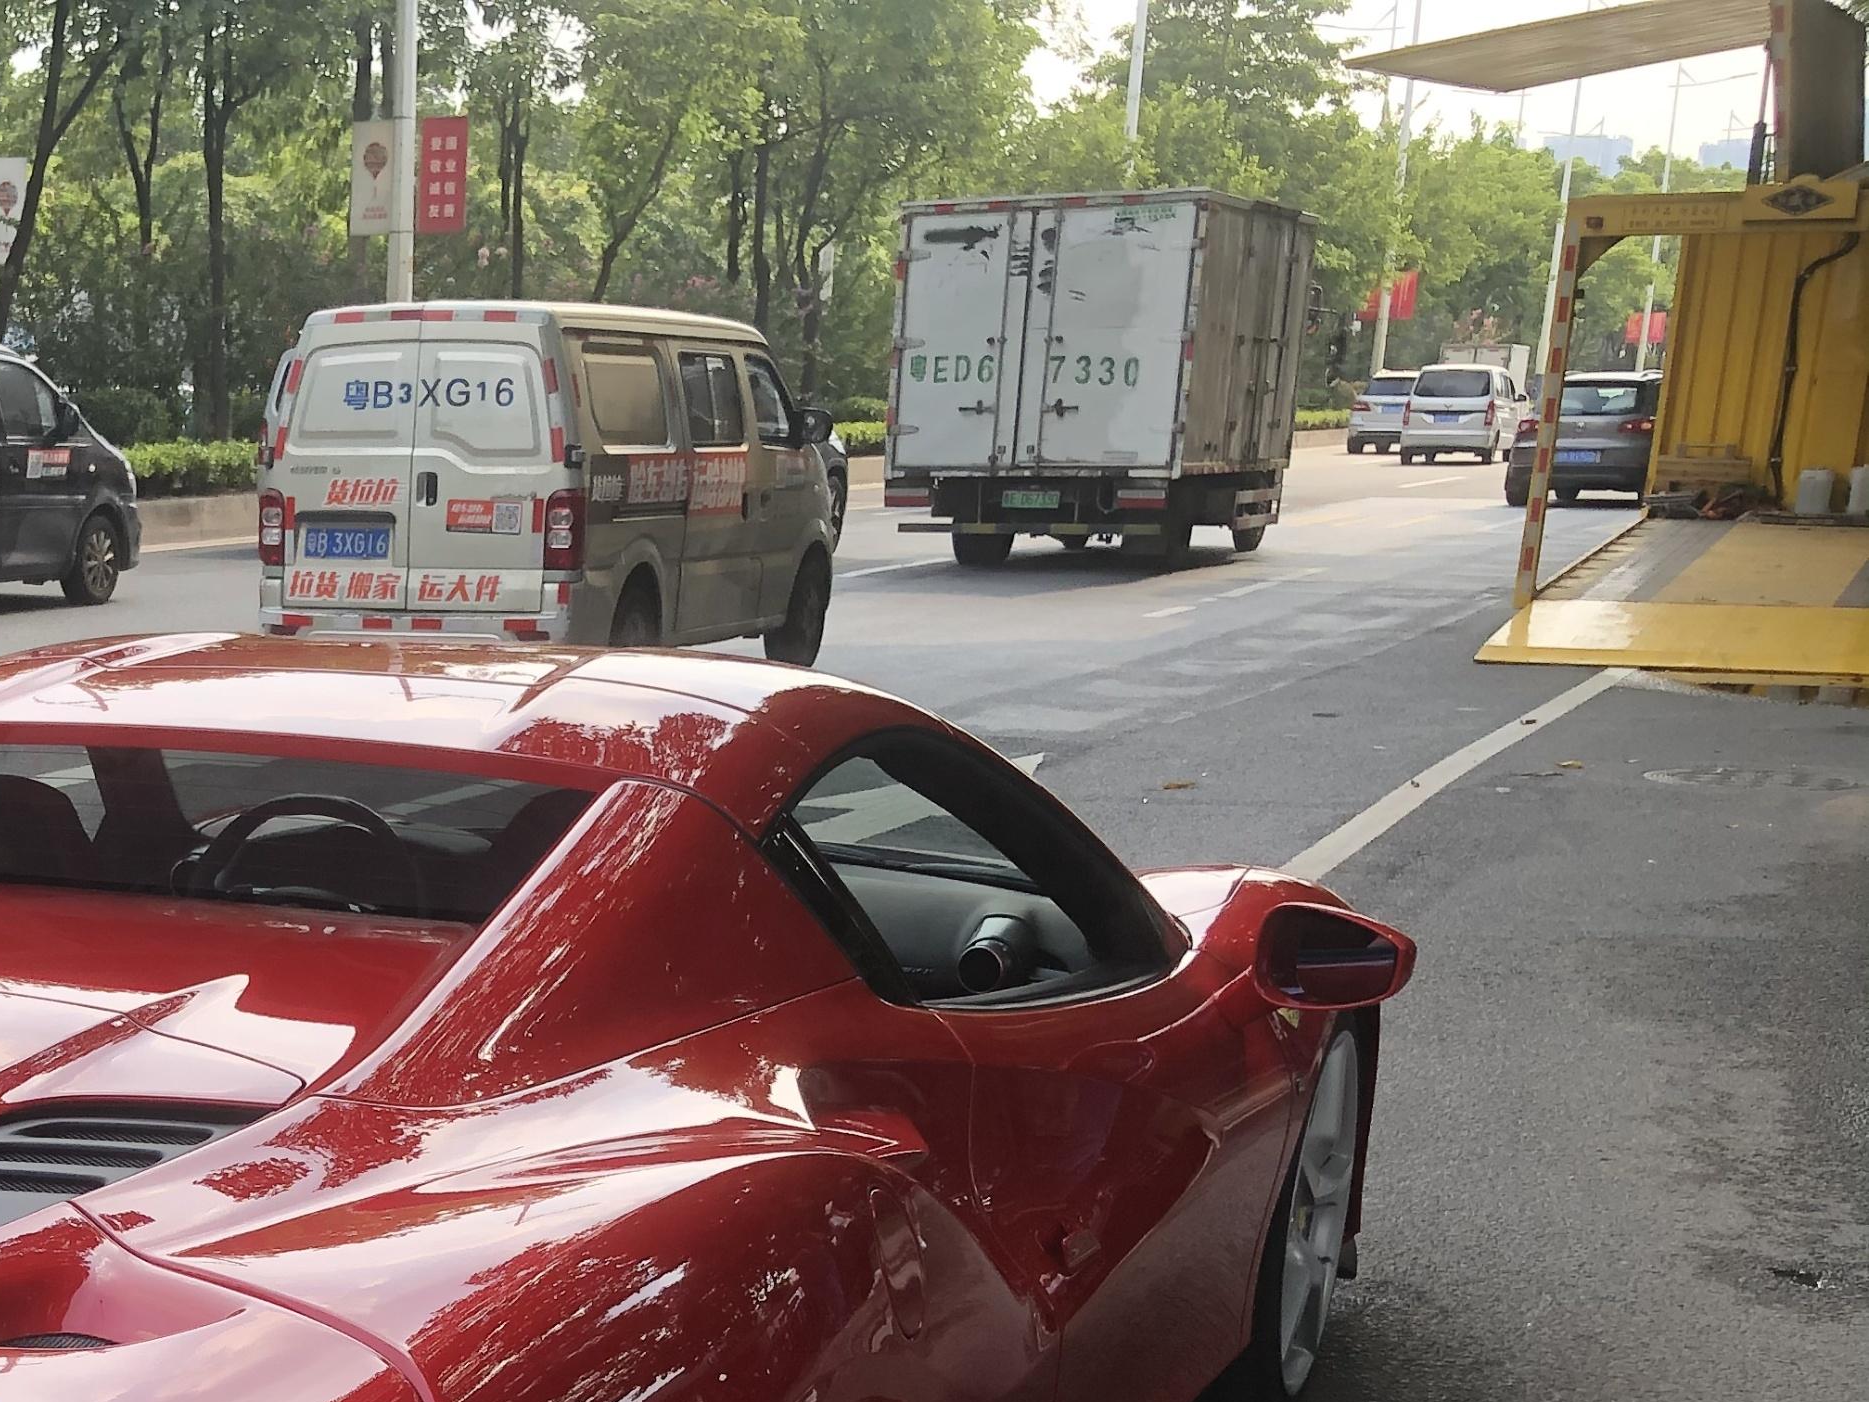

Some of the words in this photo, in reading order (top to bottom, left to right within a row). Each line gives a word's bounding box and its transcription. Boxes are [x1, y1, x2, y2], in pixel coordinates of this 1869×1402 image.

[1049, 355, 1140, 388] 7330
[325, 478, 400, 507] 货拉拉
[289, 570, 341, 600] 拉货
[346, 571, 402, 601] 搬家
[417, 573, 502, 603] 运大件
